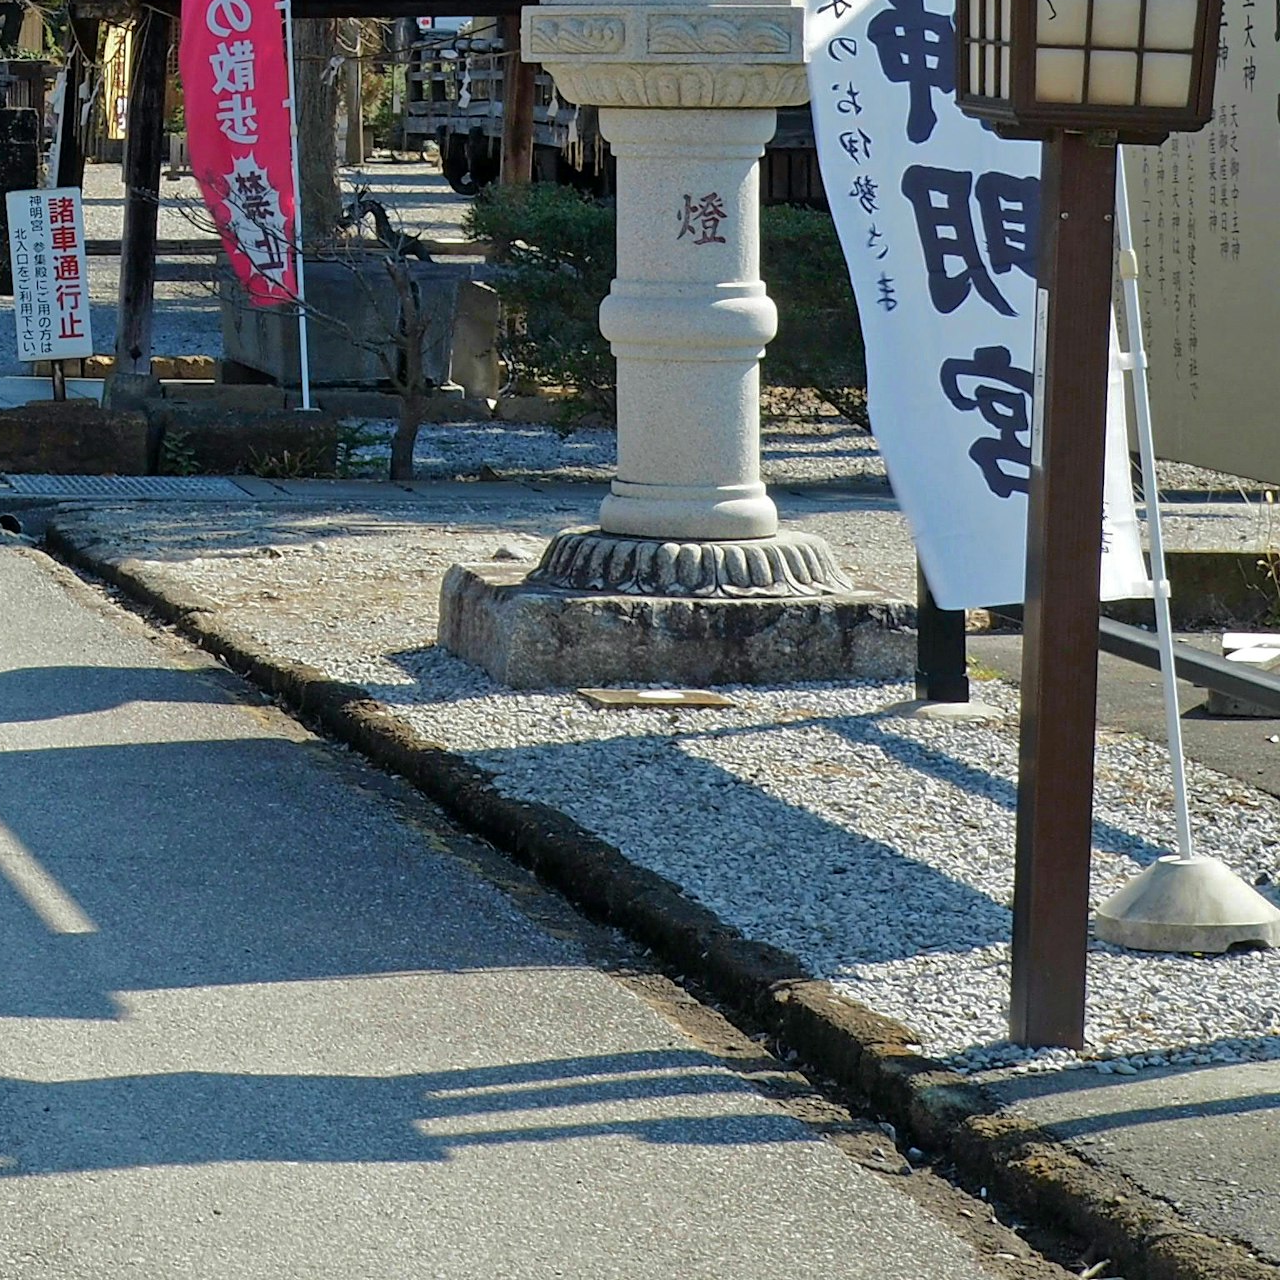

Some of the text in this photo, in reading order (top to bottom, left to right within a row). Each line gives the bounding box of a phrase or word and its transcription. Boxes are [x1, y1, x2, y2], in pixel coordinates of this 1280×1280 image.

[14, 227, 37, 357] 北入口をご利用下さい。
[29, 195, 53, 354] 神明宮、参集殿にご用の方は
[48, 196, 85, 340] 諸車通行止
